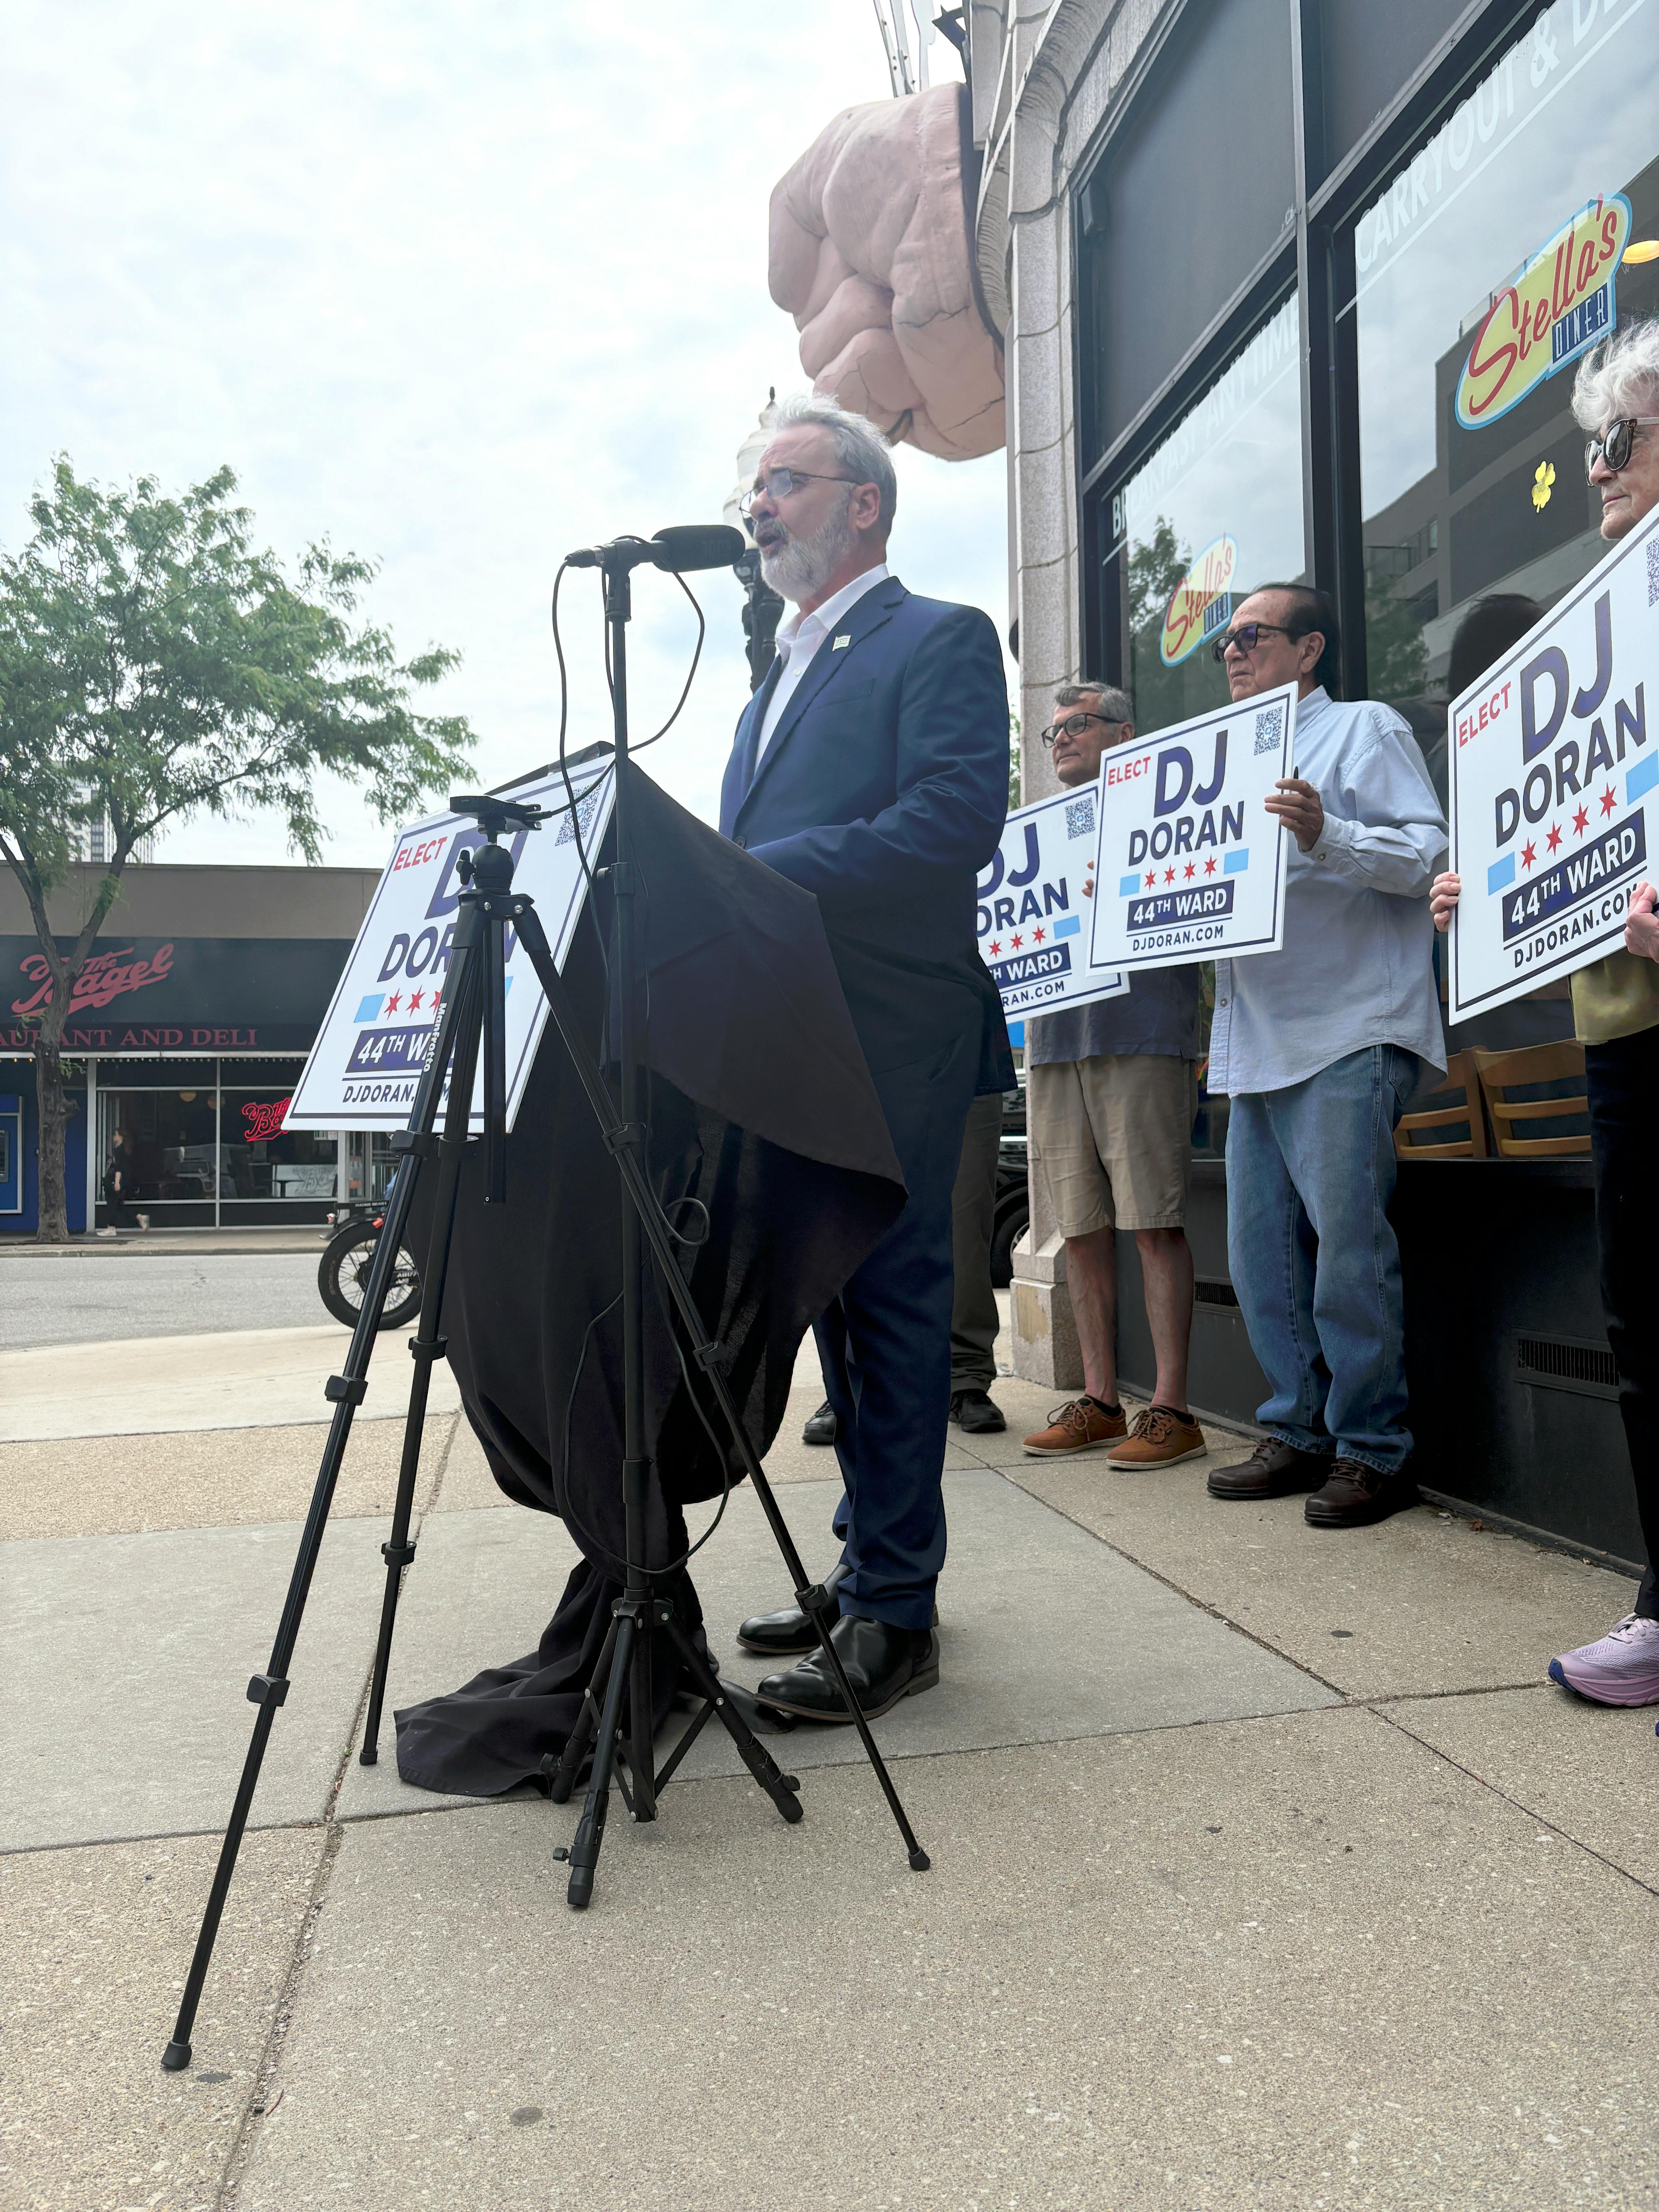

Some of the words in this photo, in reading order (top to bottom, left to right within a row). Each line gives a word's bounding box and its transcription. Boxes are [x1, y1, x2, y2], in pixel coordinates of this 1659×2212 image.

[1356, 40, 1518, 273] CARRYOUT
[1530, 8, 1560, 88] &
[1469, 192, 1617, 416] Stella's
[1555, 289, 1606, 359] DINER
[1166, 532, 1231, 657] Stella's
[1459, 680, 1511, 748] ELECT
[1520, 589, 1613, 766] DJ
[1108, 756, 1151, 786] ELECT
[1154, 730, 1228, 817] DJ
[1495, 681, 1647, 848] DORAN
[393, 836, 448, 871] ELECT
[1128, 800, 1244, 867] DORAN
[977, 877, 1069, 938] ORAN
[1133, 893, 1171, 925] 44TH
[1175, 888, 1226, 914] WARD
[1511, 872, 1561, 925] 44TH
[1566, 828, 1636, 894] WARD
[84, 947, 134, 975] The
[1006, 951, 1062, 981] WARD
[1133, 925, 1224, 951] DJDORAN.COM
[120, 1029, 183, 1046] AND
[191, 1029, 258, 1046] DELI
[357, 1034, 406, 1064] 44TH
[424, 1003, 447, 1072] Manfrotto
